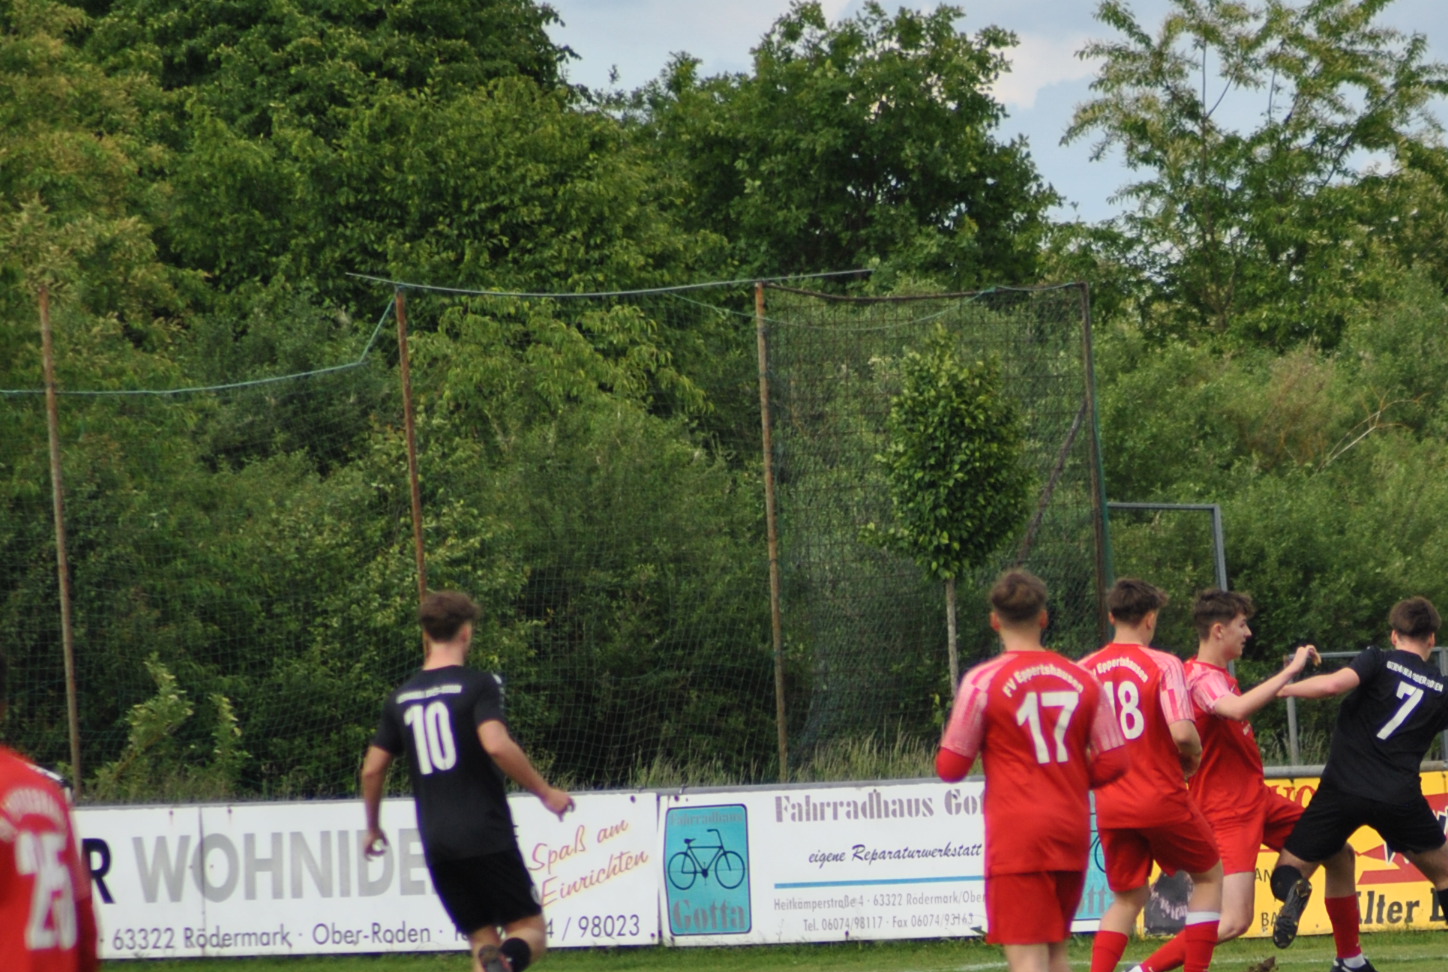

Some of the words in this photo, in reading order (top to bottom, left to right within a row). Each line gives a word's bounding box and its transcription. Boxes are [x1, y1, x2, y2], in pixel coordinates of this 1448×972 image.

[1002, 677, 1018, 698] FV
[1013, 663, 1084, 694] Eppertshausen
[1016, 691, 1079, 765] 17
[1376, 680, 1425, 740] 7
[403, 701, 457, 775] 10
[774, 791, 934, 823] Fahrradhaus
[528, 824, 586, 875] Spaß
[597, 819, 628, 843] am
[809, 849, 846, 869] eigene
[851, 841, 982, 866] Reparaturwerkstatt
[132, 827, 438, 904] WOHNIDE
[540, 851, 648, 907] Einrichten
[673, 899, 745, 930] Gotta
[873, 893, 903, 907] 63322
[1356, 890, 1420, 925] lter
[112, 926, 175, 951] 63322
[183, 923, 292, 949] Rödermark
[312, 921, 431, 946] Ober-Roden
[578, 914, 640, 938] 98023
[803, 918, 819, 931] Tel.
[892, 915, 908, 928] Fax
